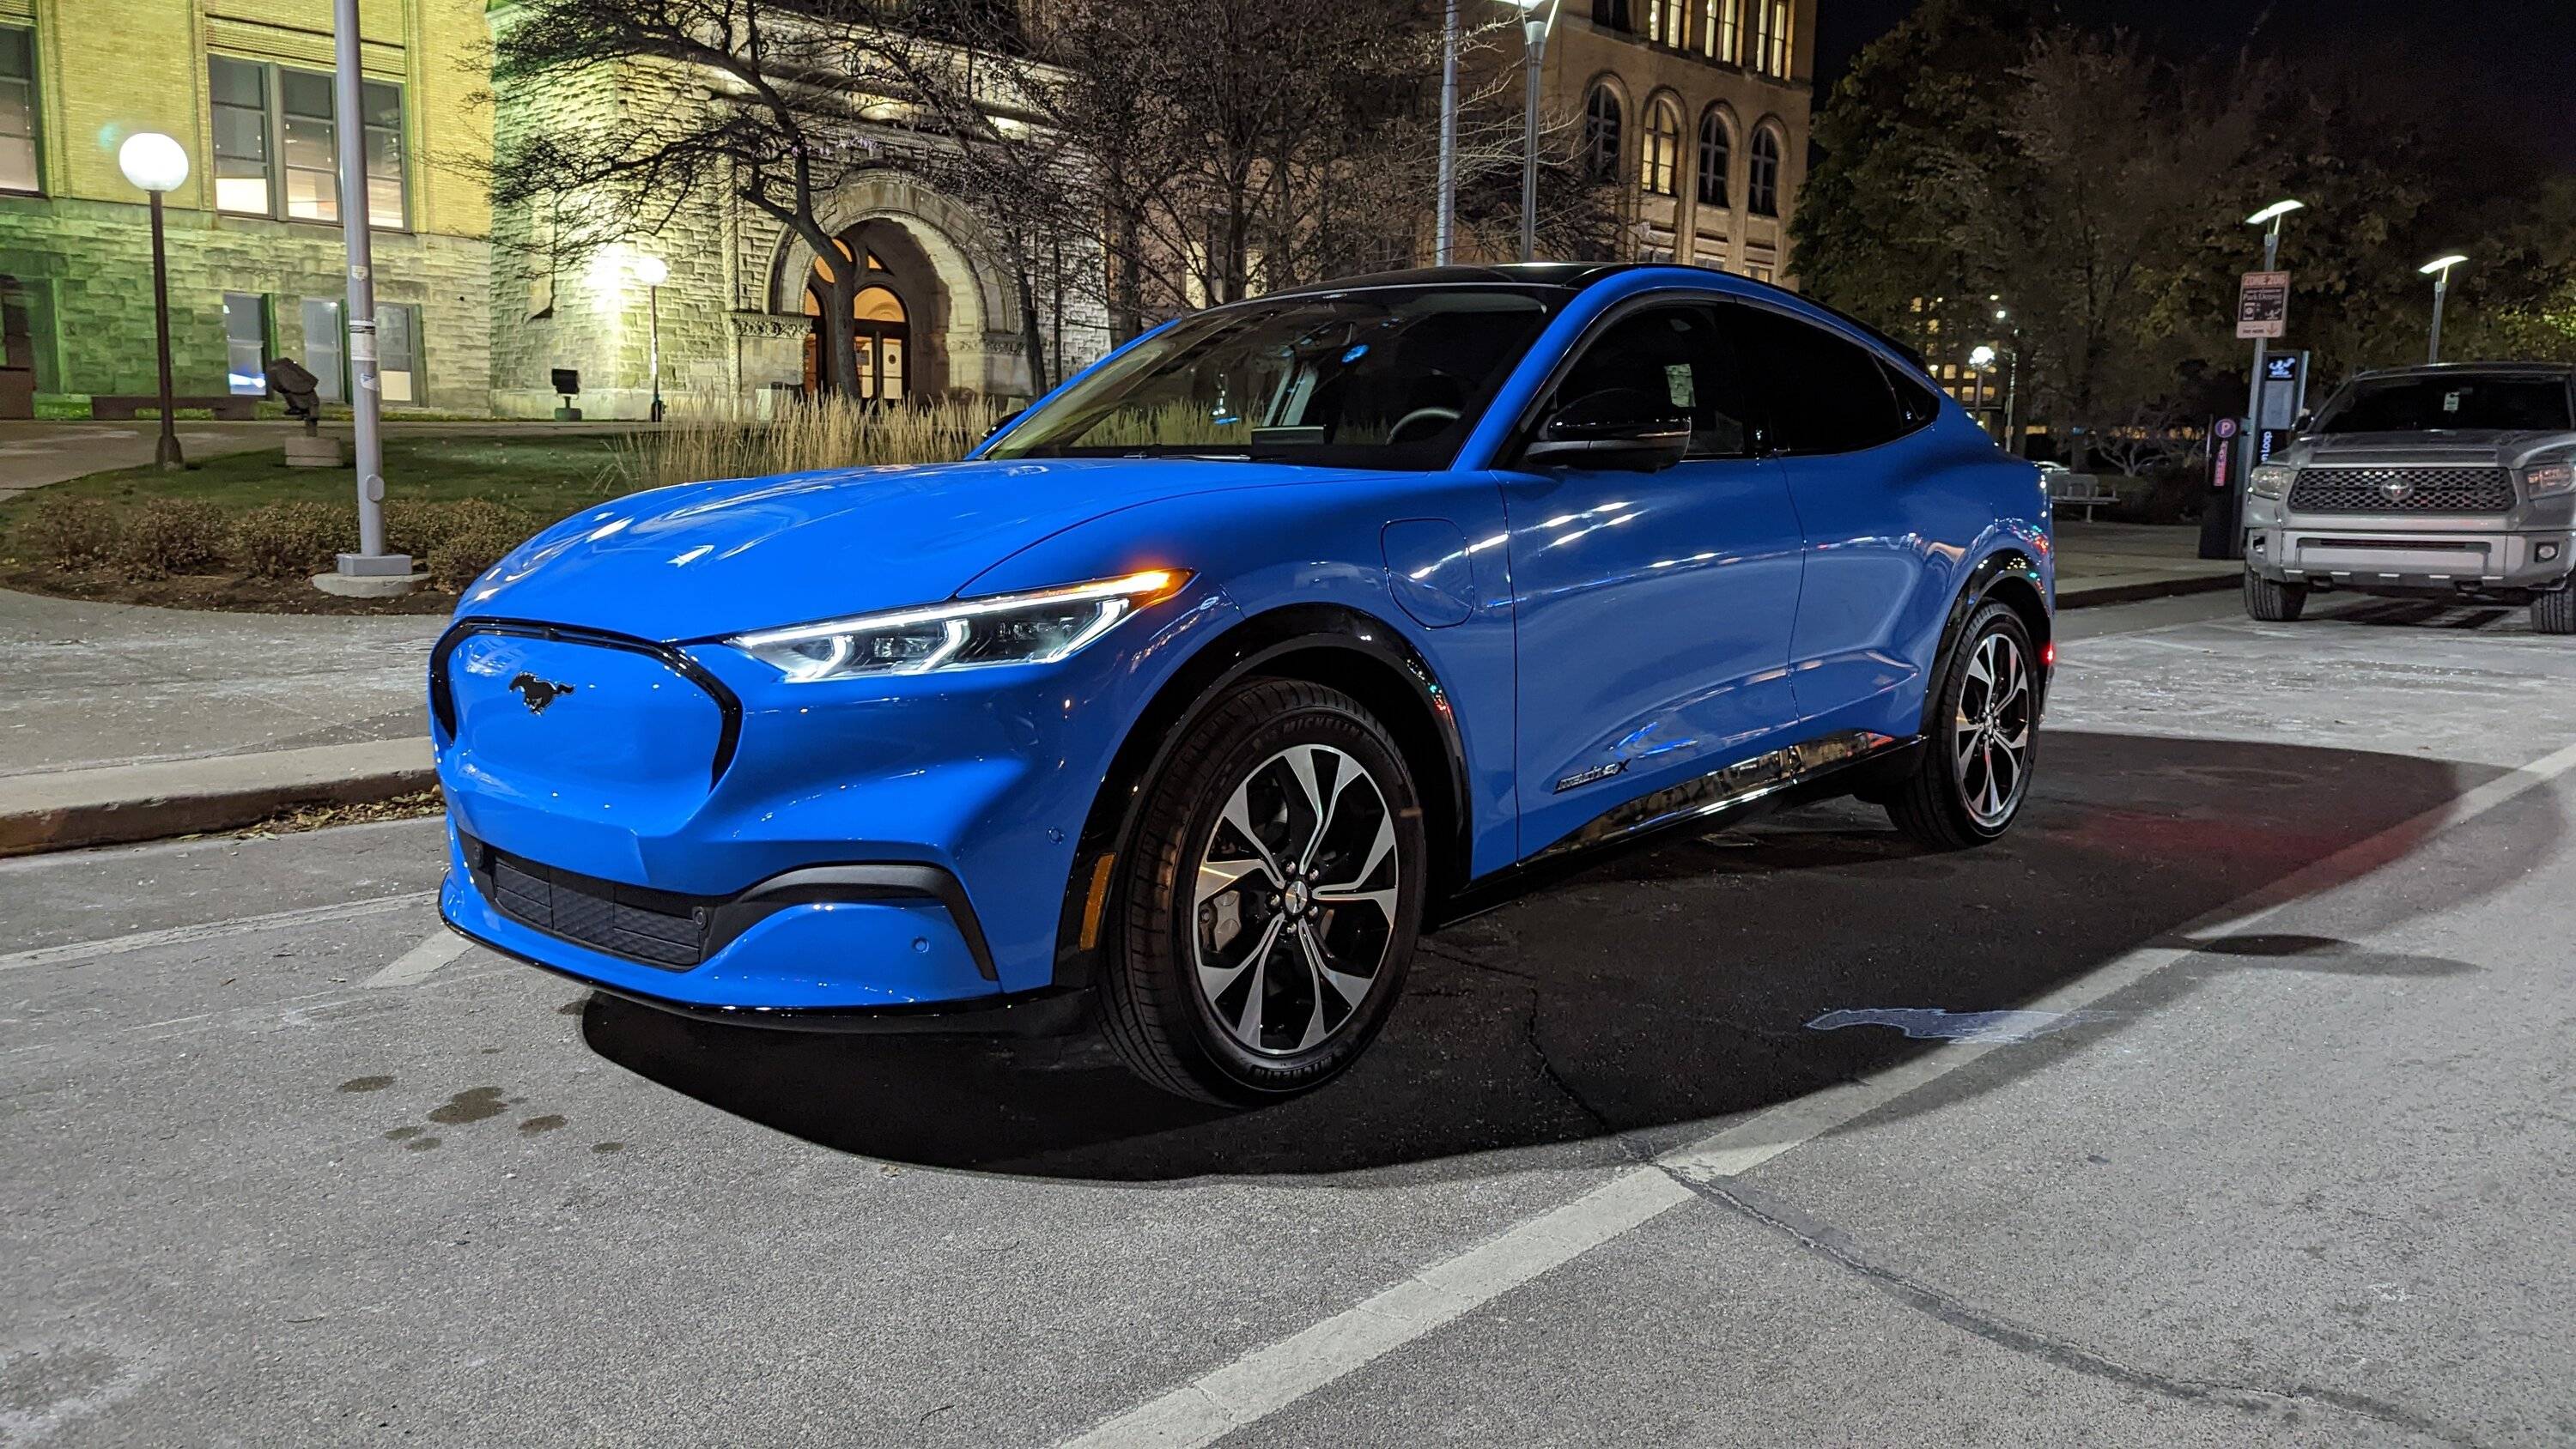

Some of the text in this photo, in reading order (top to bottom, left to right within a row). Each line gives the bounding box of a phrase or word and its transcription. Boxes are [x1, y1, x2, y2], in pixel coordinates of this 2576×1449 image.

[2221, 421, 2231, 434] P
[2260, 431, 2273, 453] Loop
[1283, 716, 1361, 735] MICHELIN
